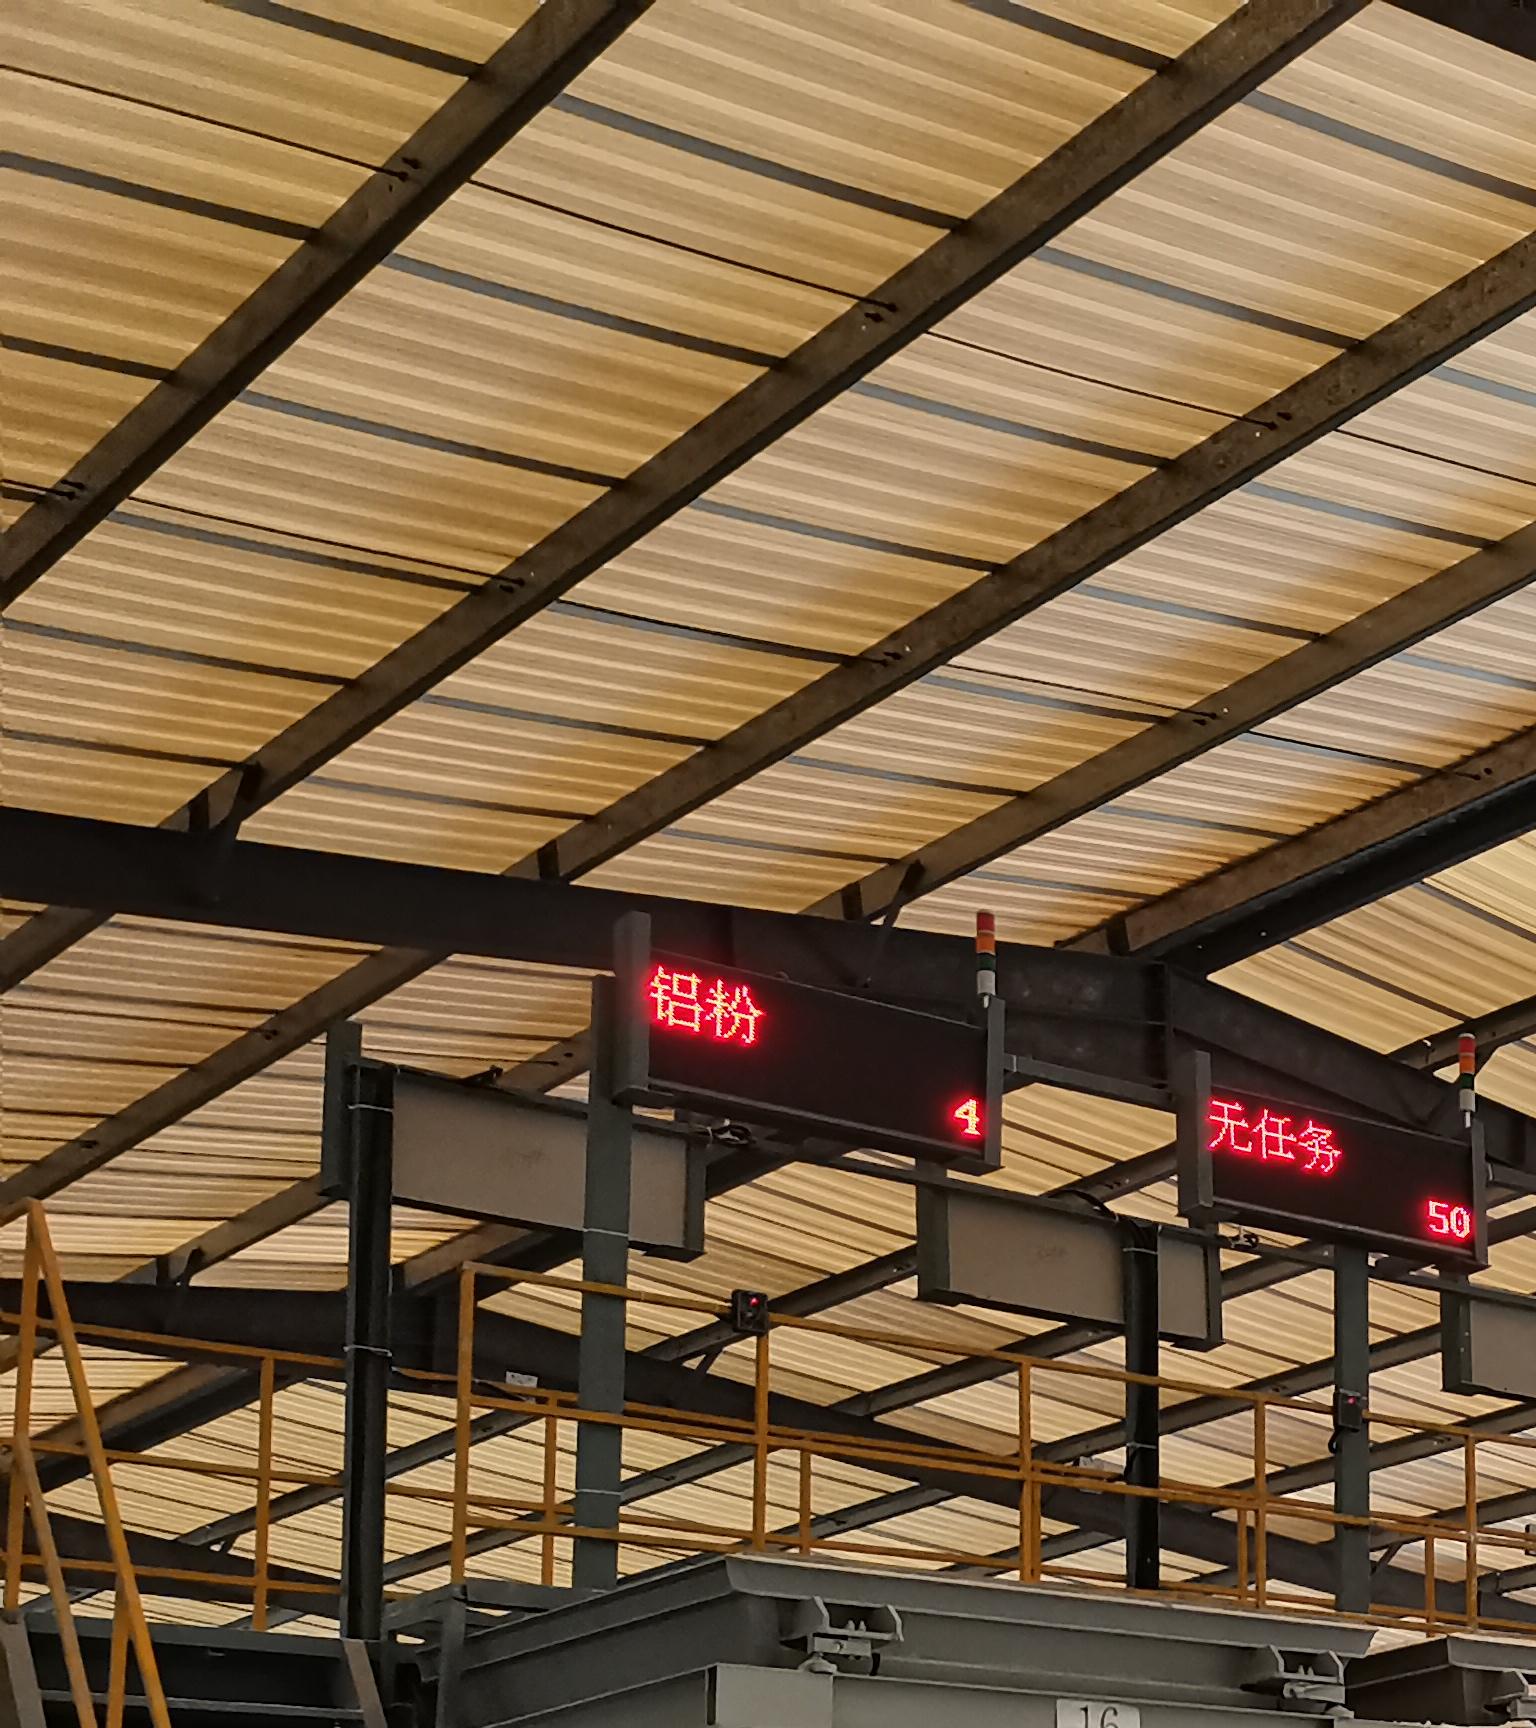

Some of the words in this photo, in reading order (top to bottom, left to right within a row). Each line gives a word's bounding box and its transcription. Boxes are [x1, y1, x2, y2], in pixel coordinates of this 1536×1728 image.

[649, 965, 764, 1045] 铝粉
[953, 1098, 982, 1137] 4
[1208, 1099, 1343, 1173] 无任务
[1427, 1199, 1472, 1239] 50
